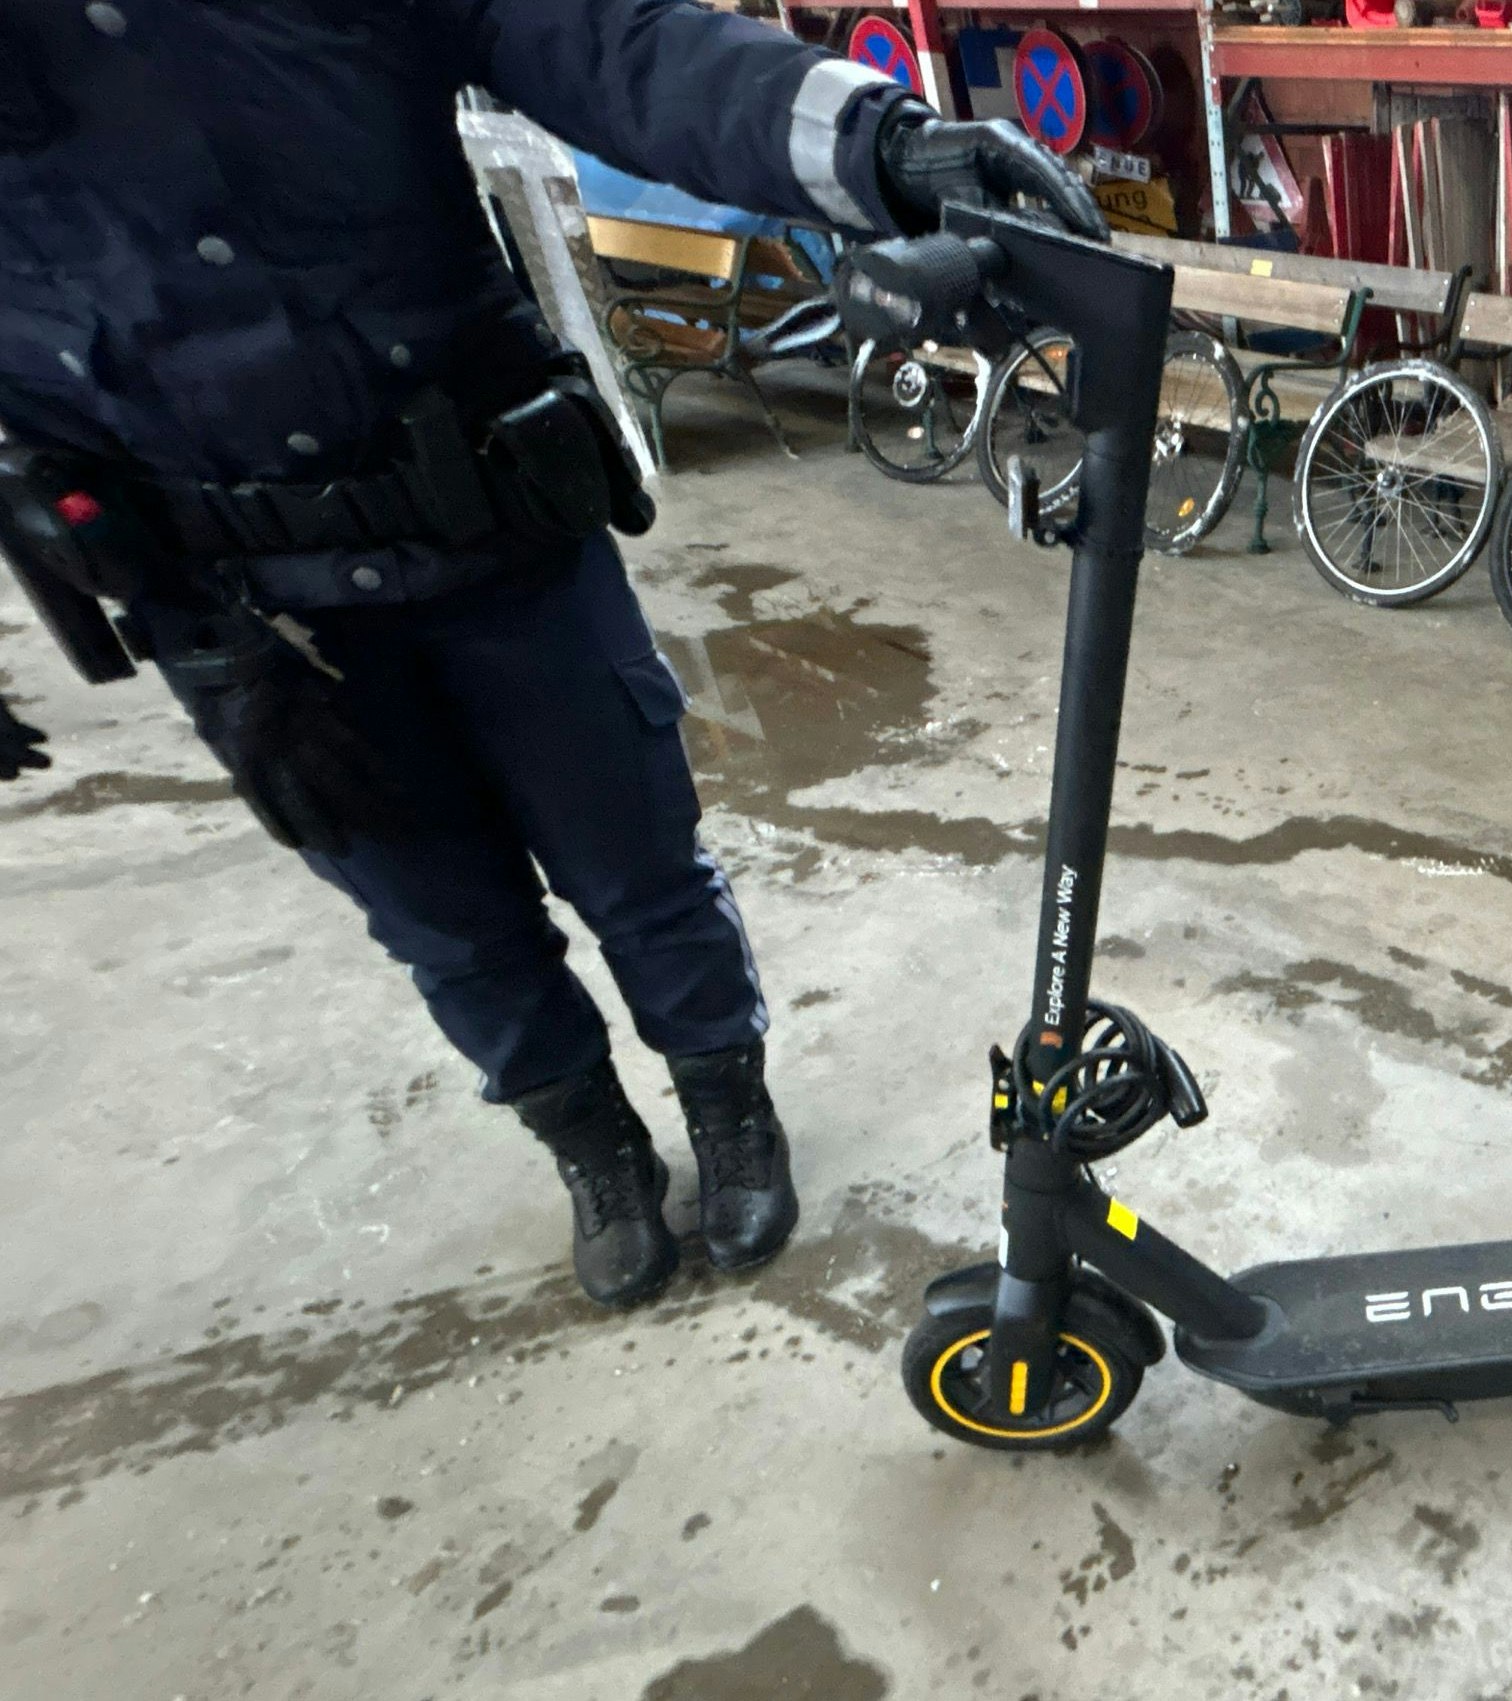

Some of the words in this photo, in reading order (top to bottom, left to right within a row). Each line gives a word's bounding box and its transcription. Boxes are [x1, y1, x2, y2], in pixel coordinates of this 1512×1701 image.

[1057, 864, 1078, 903] Way
[1053, 907, 1071, 947] New
[1051, 950, 1067, 964] A
[1044, 965, 1066, 1026] Explore
